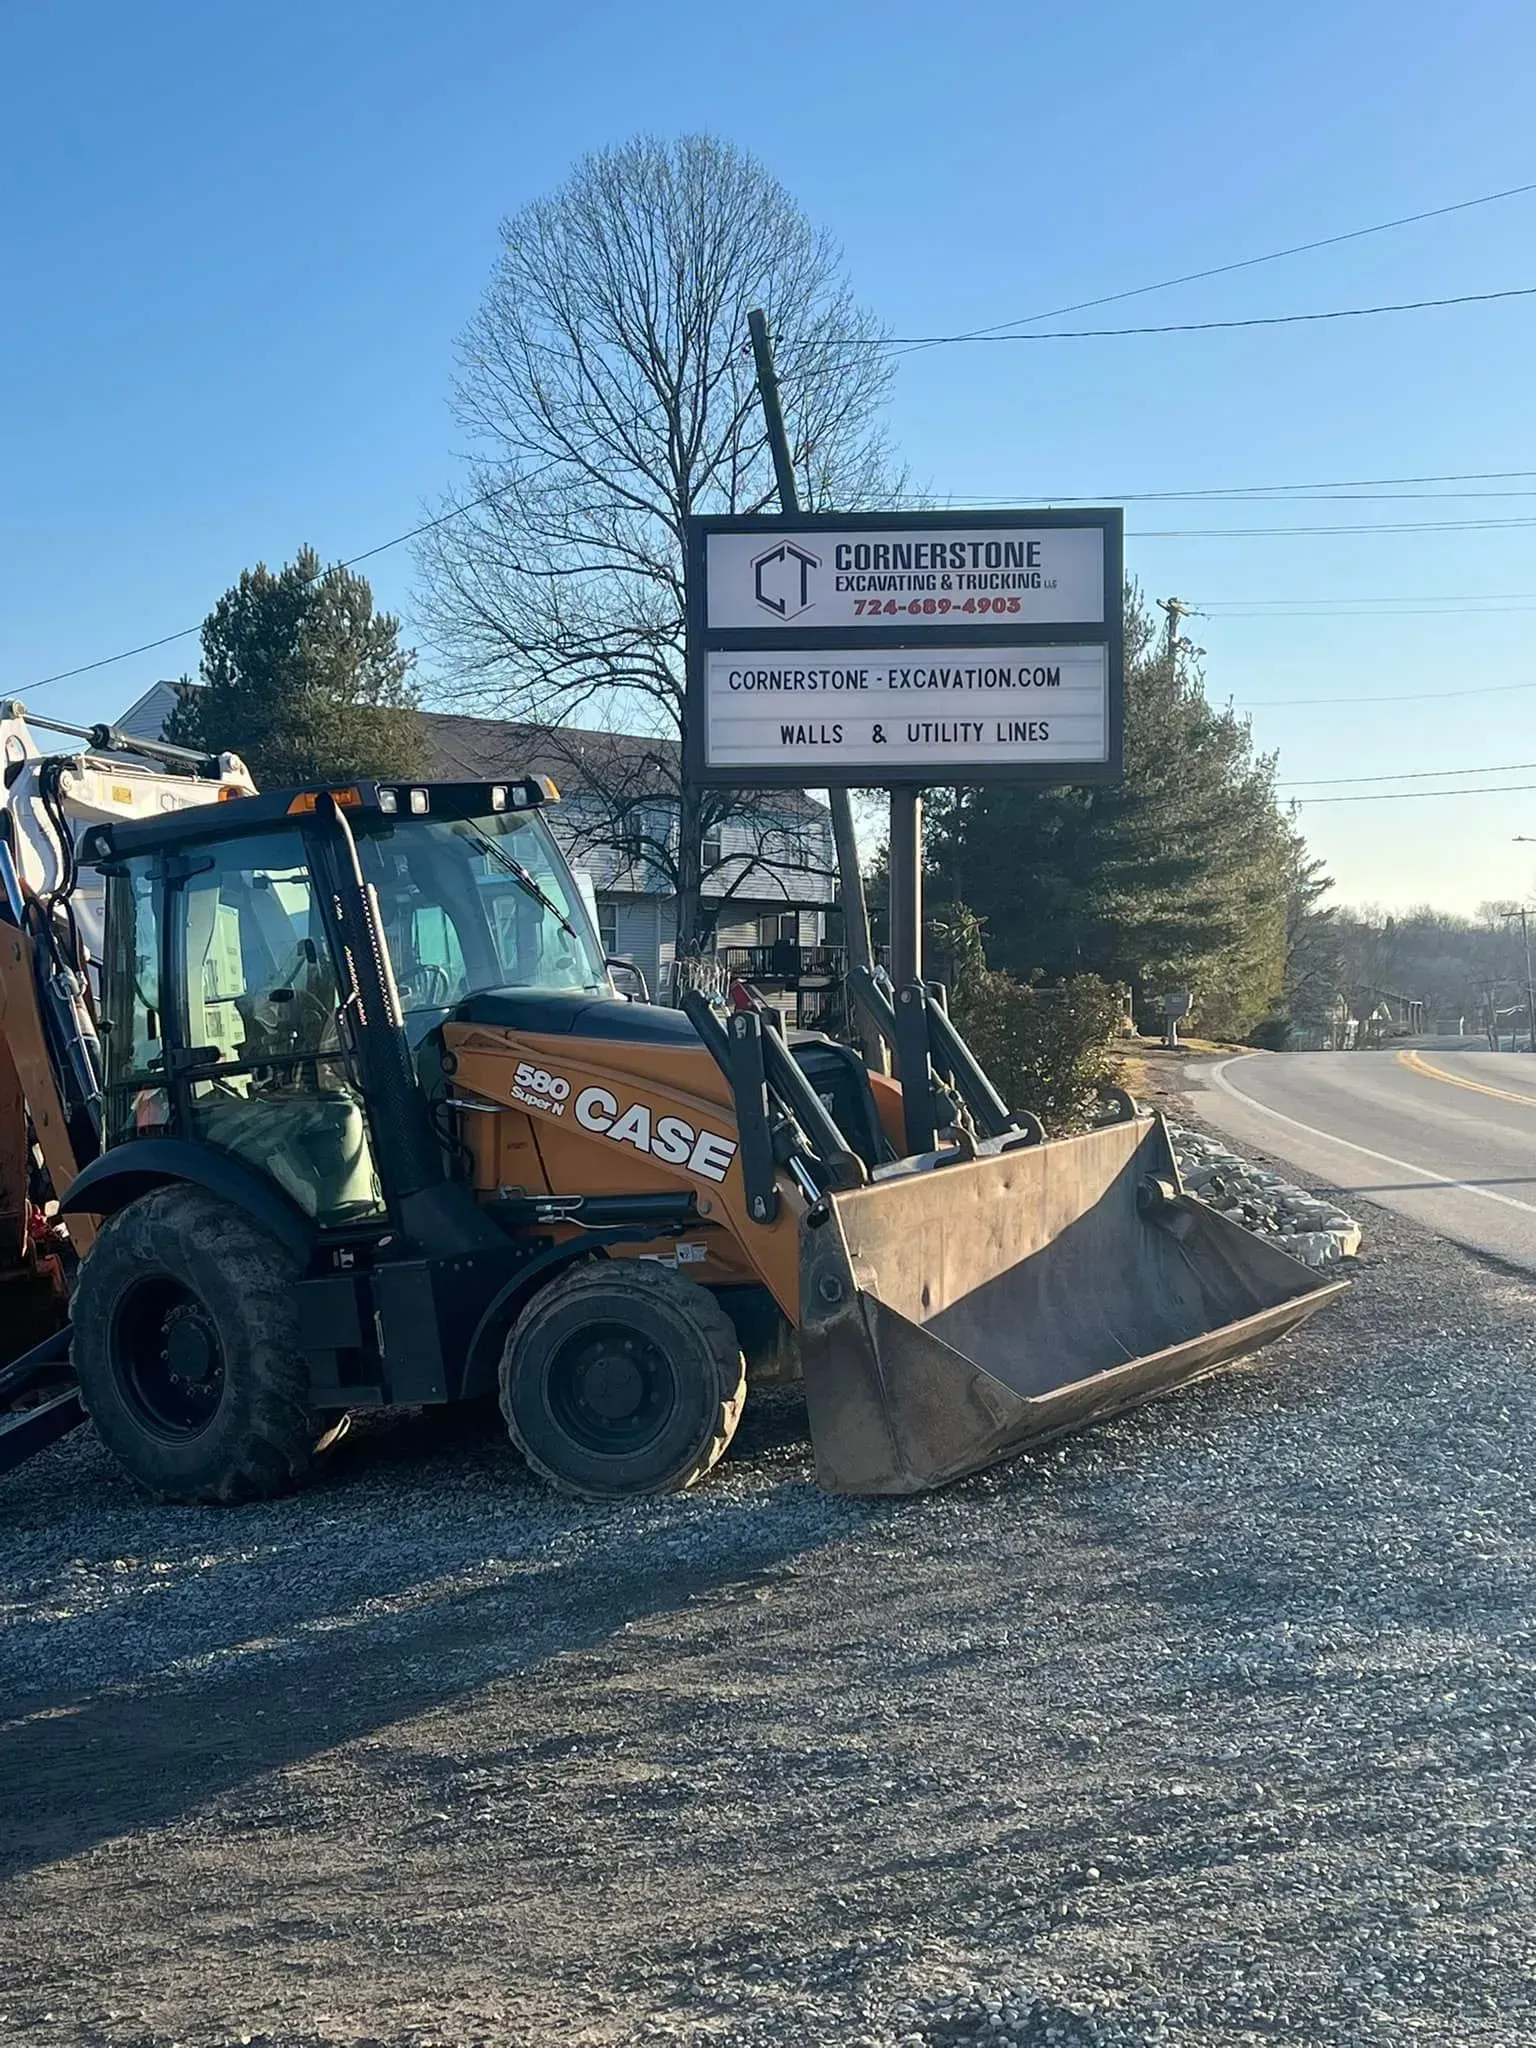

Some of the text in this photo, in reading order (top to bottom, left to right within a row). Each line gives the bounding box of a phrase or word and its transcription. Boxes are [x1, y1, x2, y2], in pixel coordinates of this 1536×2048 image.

[835, 541, 1041, 571] CORNERSTONE
[835, 574, 937, 592] EXCAVATING
[940, 573, 952, 591] &
[956, 572, 1041, 590] TRUCKING
[854, 597, 1022, 616] 724-689-4903
[729, 670, 869, 690] CORNERSTONE
[888, 666, 1061, 689] EXCAVATION.COM
[780, 721, 1049, 745] WALLS & UTILITY LINES
[513, 1061, 571, 1101] 580
[510, 1085, 565, 1117] Super N
[573, 1085, 739, 1184] CASE
